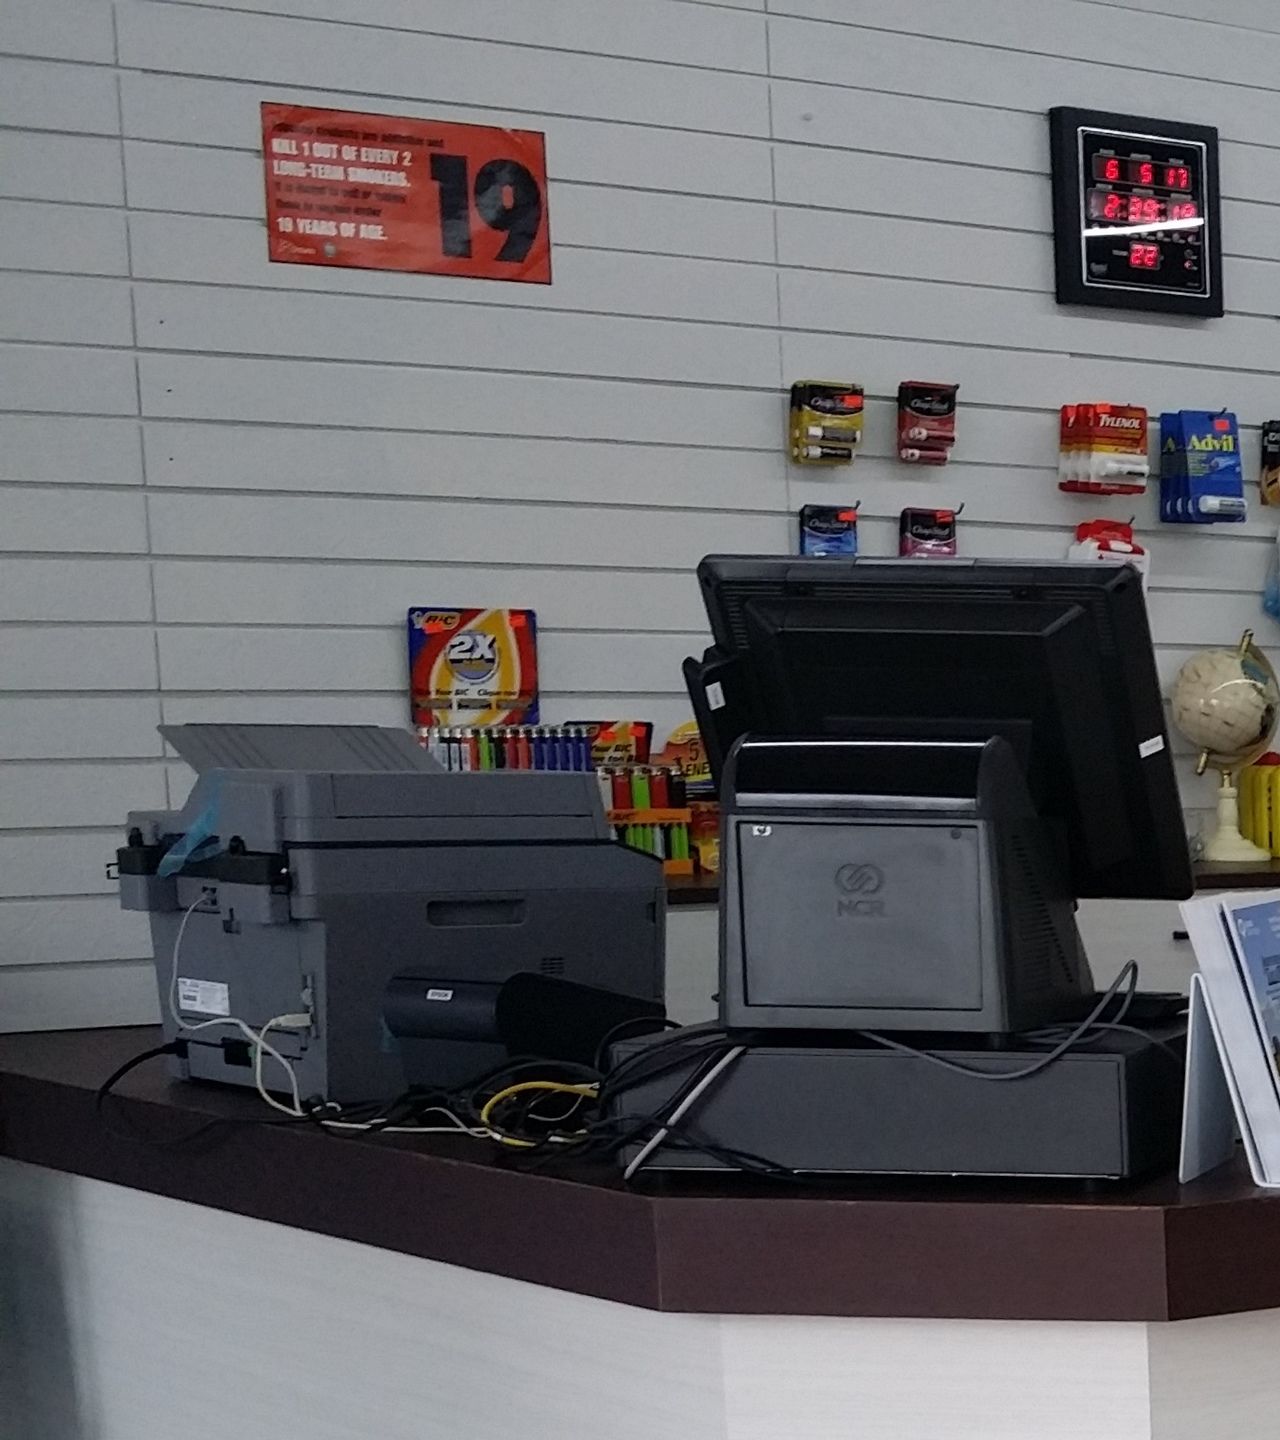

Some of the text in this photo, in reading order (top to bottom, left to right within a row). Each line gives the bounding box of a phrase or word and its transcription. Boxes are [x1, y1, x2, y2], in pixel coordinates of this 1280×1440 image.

[302, 142, 310, 156] 1
[312, 142, 338, 160] OUT
[341, 144, 358, 161] OF
[360, 147, 399, 165] EVERY
[401, 150, 413, 166] 2
[430, 152, 542, 263] 19
[297, 218, 338, 237] YEARS
[339, 222, 357, 238] OF
[1099, 413, 1141, 430] TYLENOL
[1188, 434, 1235, 452] Advil
[449, 635, 497, 660] 2X
